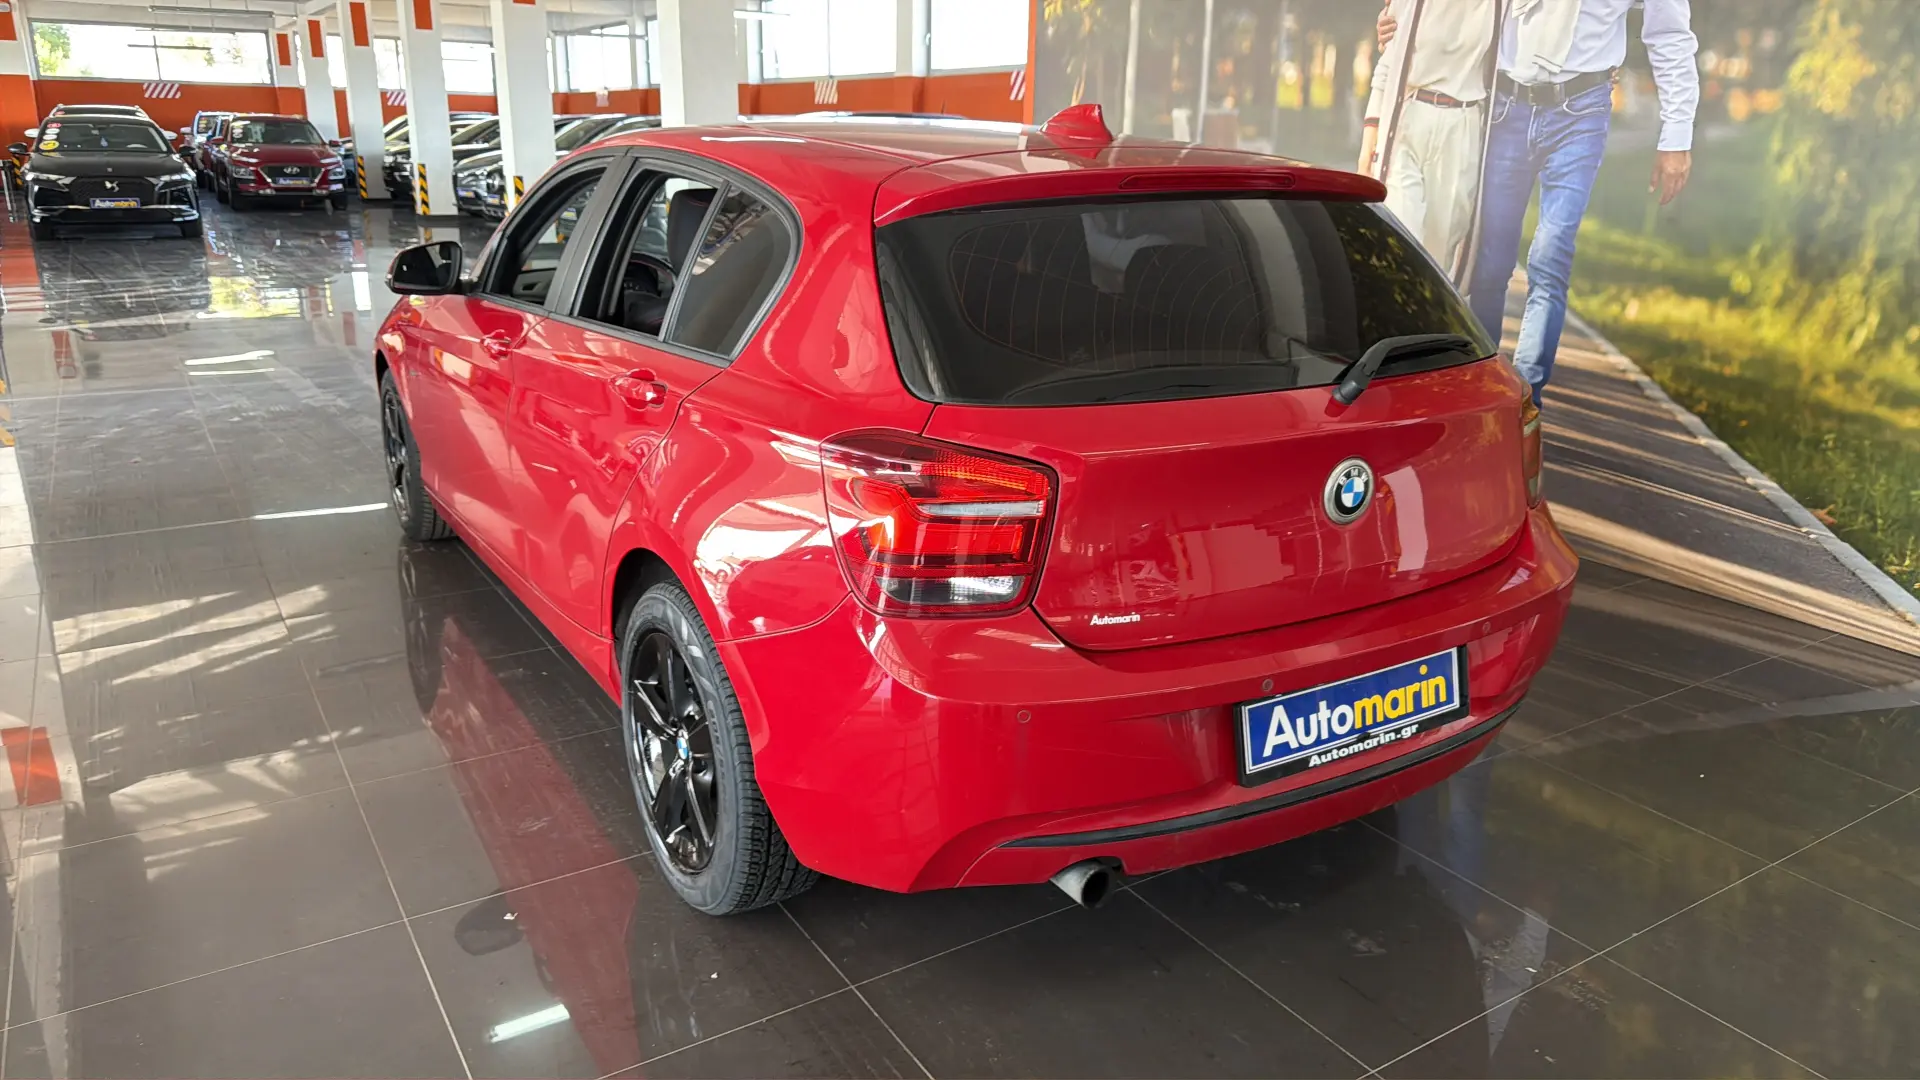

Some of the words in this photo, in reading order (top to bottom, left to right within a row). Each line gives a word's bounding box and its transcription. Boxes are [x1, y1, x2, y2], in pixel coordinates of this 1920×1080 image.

[1338, 468, 1368, 485] BMW
[1089, 612, 1141, 626] Automarin
[1262, 664, 1447, 758] Automarin
[1308, 724, 1419, 768] Automarin.gr
